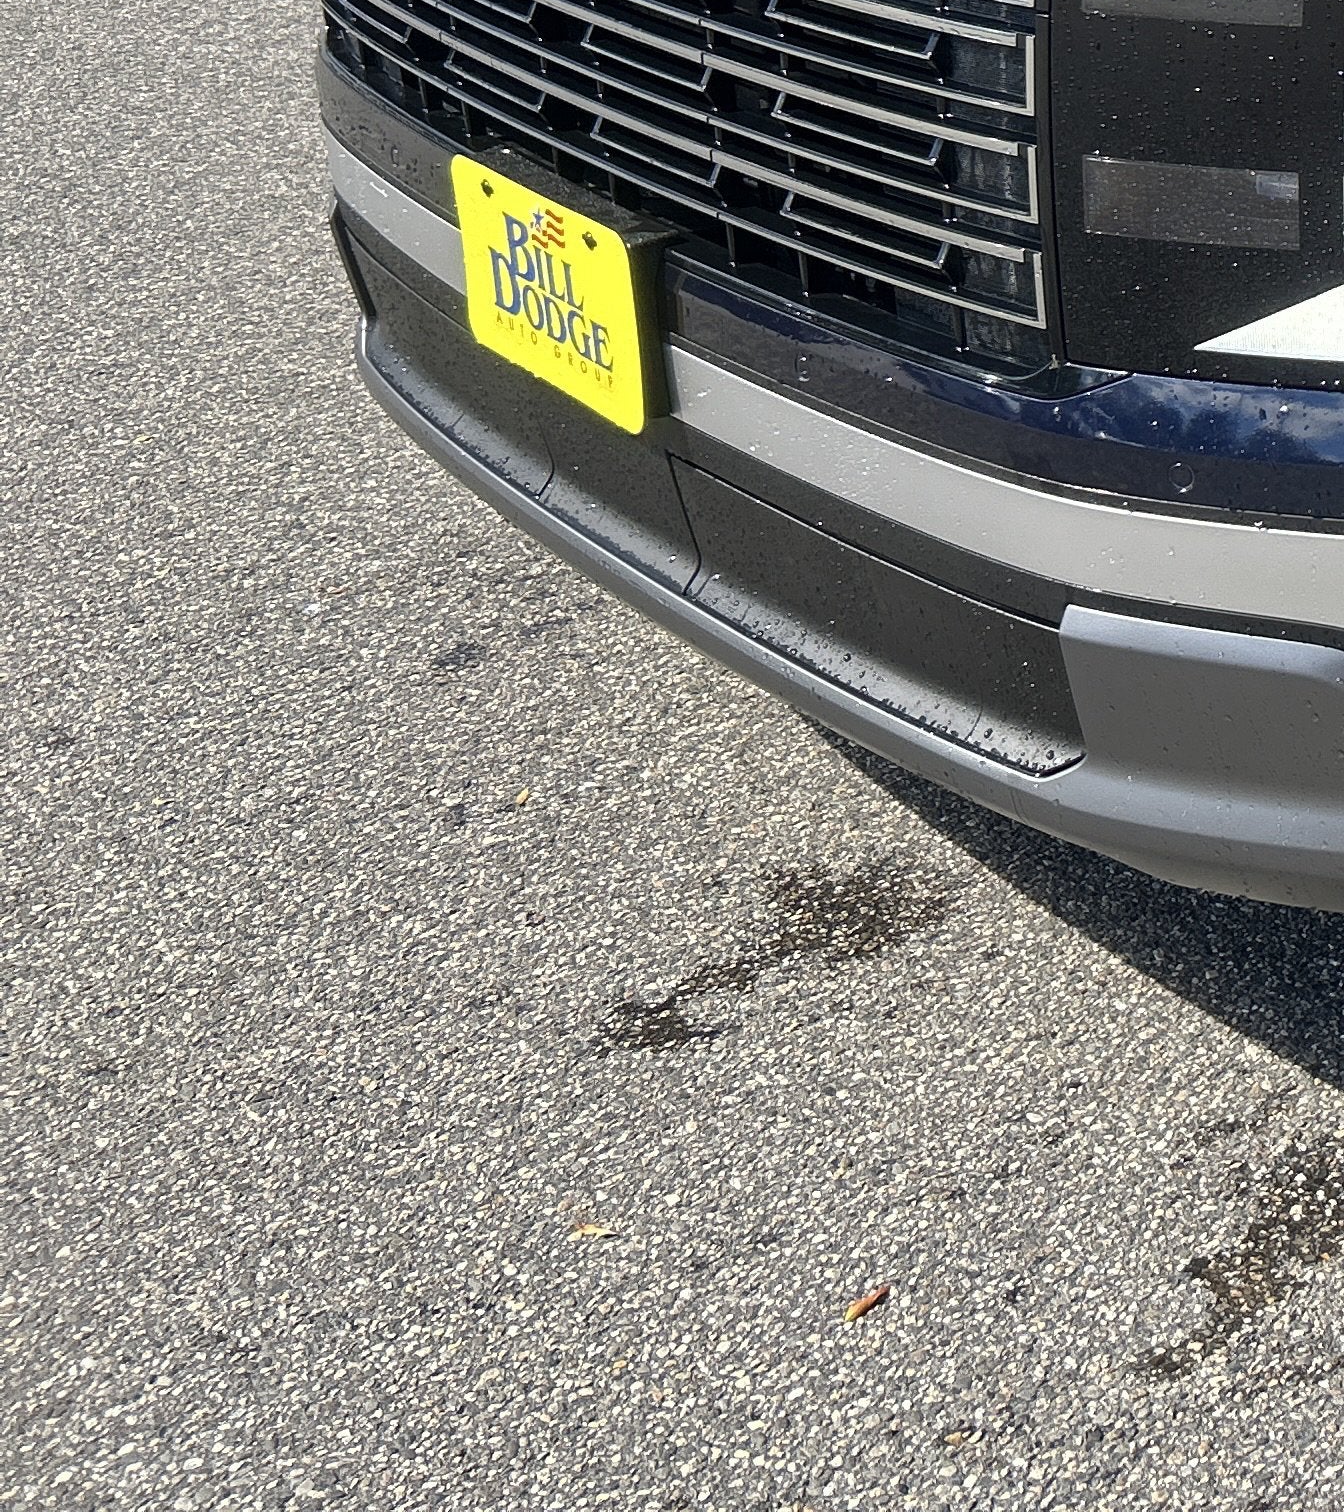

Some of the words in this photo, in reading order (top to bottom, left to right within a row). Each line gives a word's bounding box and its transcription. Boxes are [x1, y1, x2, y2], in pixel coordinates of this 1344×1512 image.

[488, 245, 614, 372] DODGE
[501, 210, 585, 312] BILL
[496, 314, 538, 346] AUTO
[553, 344, 614, 389] GROUP
